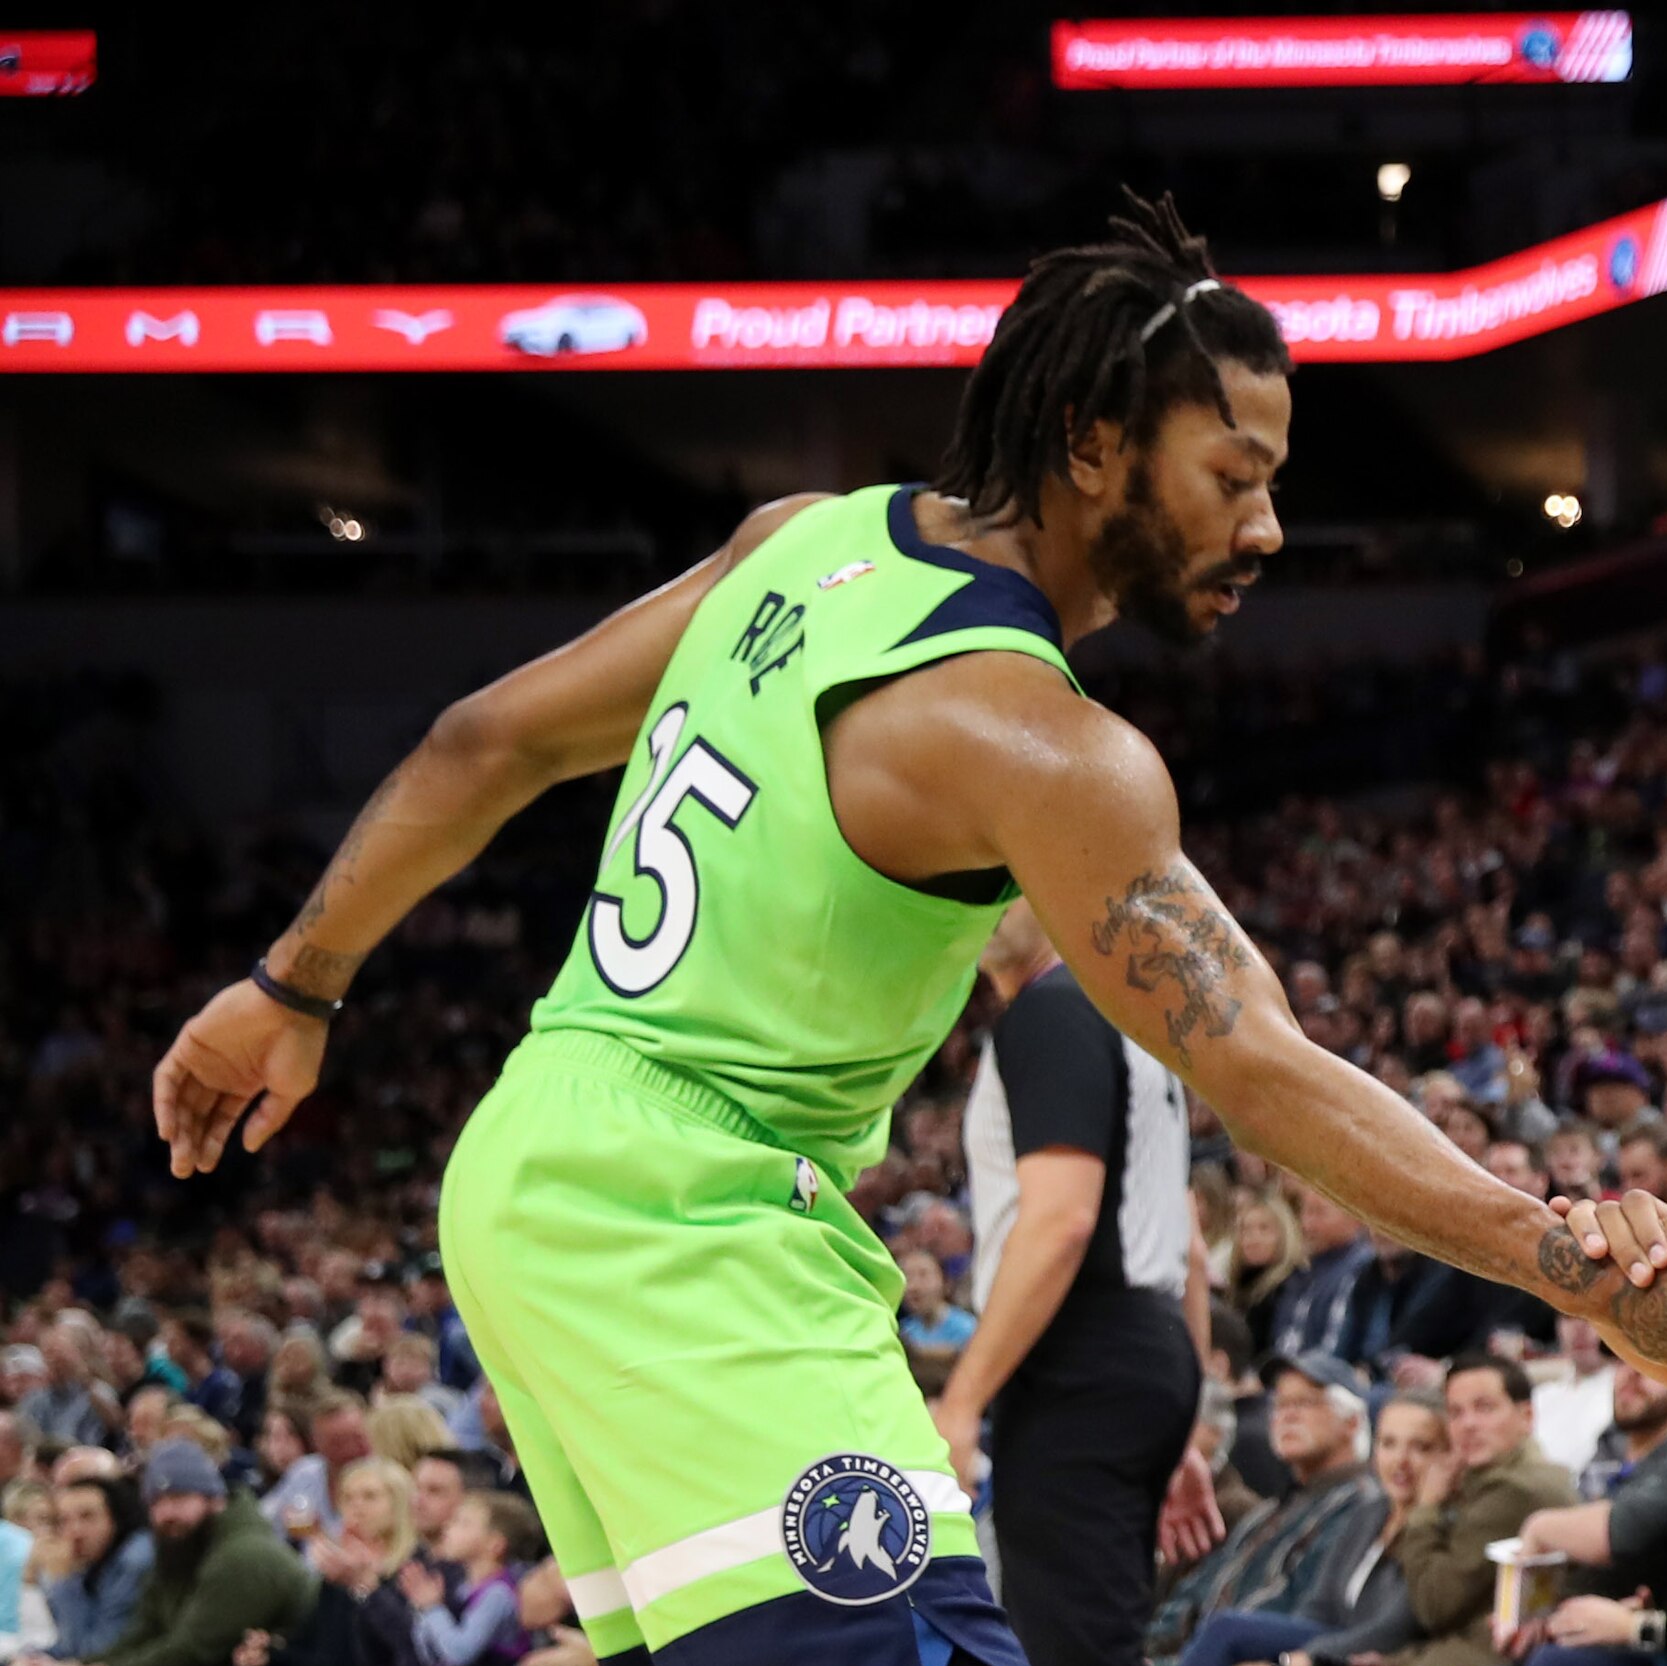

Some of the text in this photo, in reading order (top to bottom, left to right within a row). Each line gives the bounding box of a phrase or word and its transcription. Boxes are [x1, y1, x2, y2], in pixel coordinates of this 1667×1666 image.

[691, 296, 830, 349] Proud
[833, 296, 1001, 347] Partner
[1389, 253, 1598, 341] Timberwolves
[587, 701, 760, 999] 25
[784, 1457, 928, 1567] MINNESOTA TIMBERWOLVES
